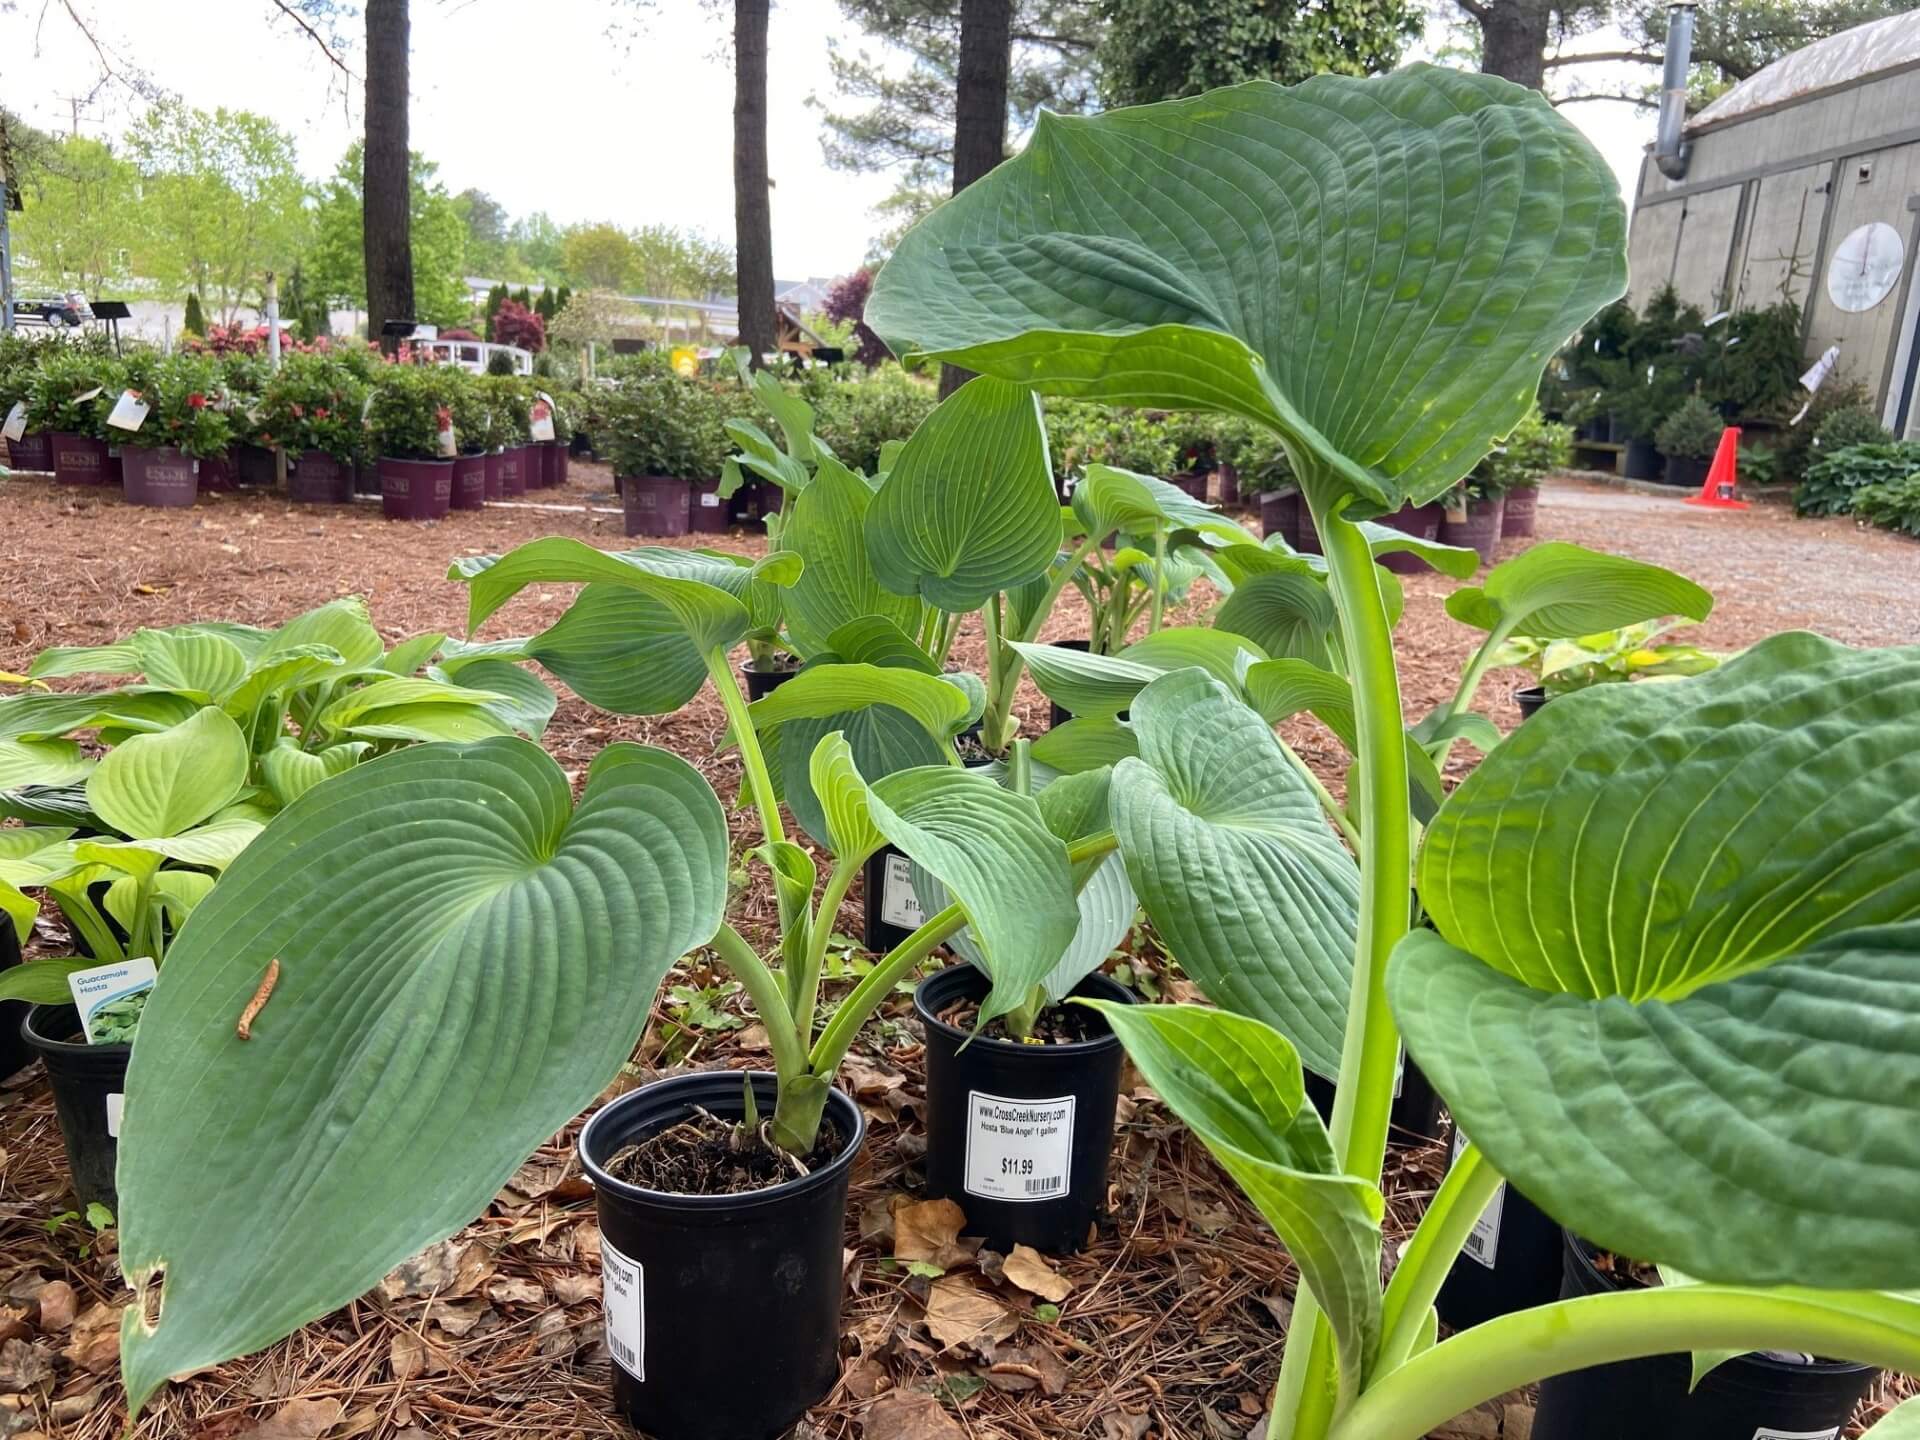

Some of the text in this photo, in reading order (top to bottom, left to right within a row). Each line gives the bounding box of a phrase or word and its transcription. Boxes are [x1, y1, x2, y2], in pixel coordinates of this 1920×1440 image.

[77, 968, 128, 985] Guacamole
[80, 984, 108, 994] Hosta
[979, 1106, 1066, 1124] www.CrossCreekNursery.com
[981, 1121, 998, 1132] Hosta
[1040, 1126, 1058, 1137] gallon
[1001, 1157, 1033, 1176] $11.99
